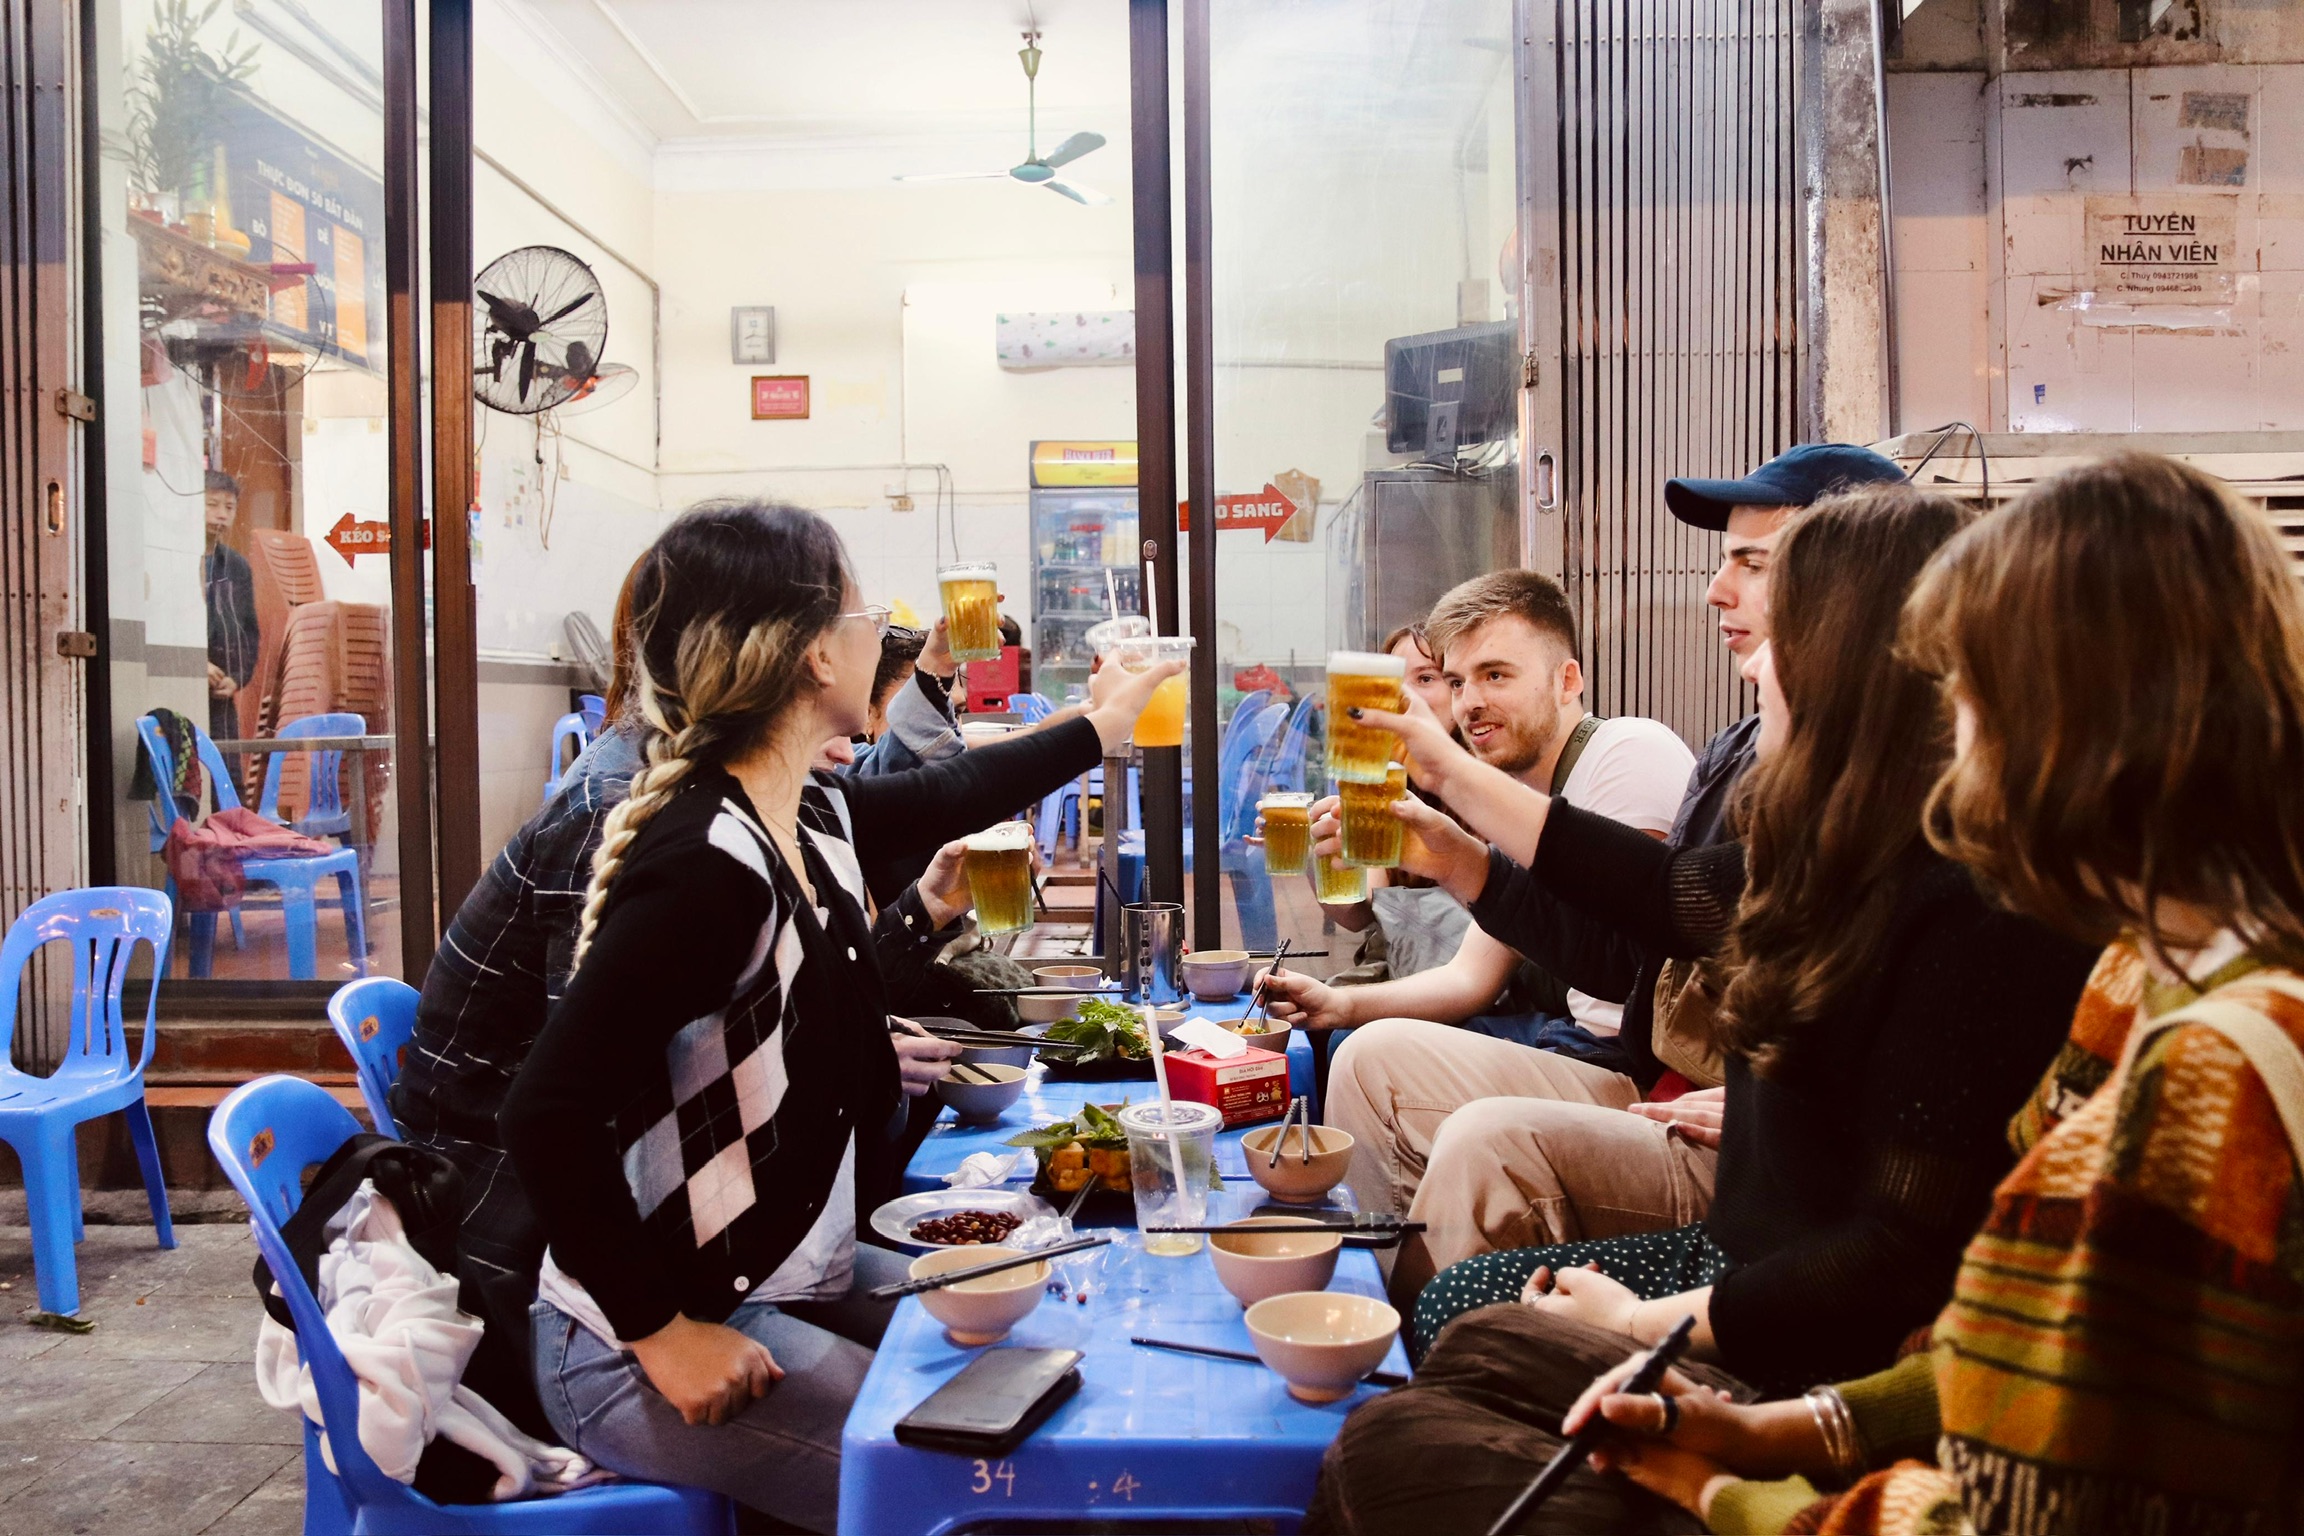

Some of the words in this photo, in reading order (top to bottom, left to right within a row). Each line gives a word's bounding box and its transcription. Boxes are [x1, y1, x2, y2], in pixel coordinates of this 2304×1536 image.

[2101, 240, 2162, 261] NHÂN
[2169, 240, 2218, 261] VIÊN
[1232, 502, 1284, 518] SANG
[340, 526, 374, 544] KÉO
[971, 1458, 1016, 1497] 34
